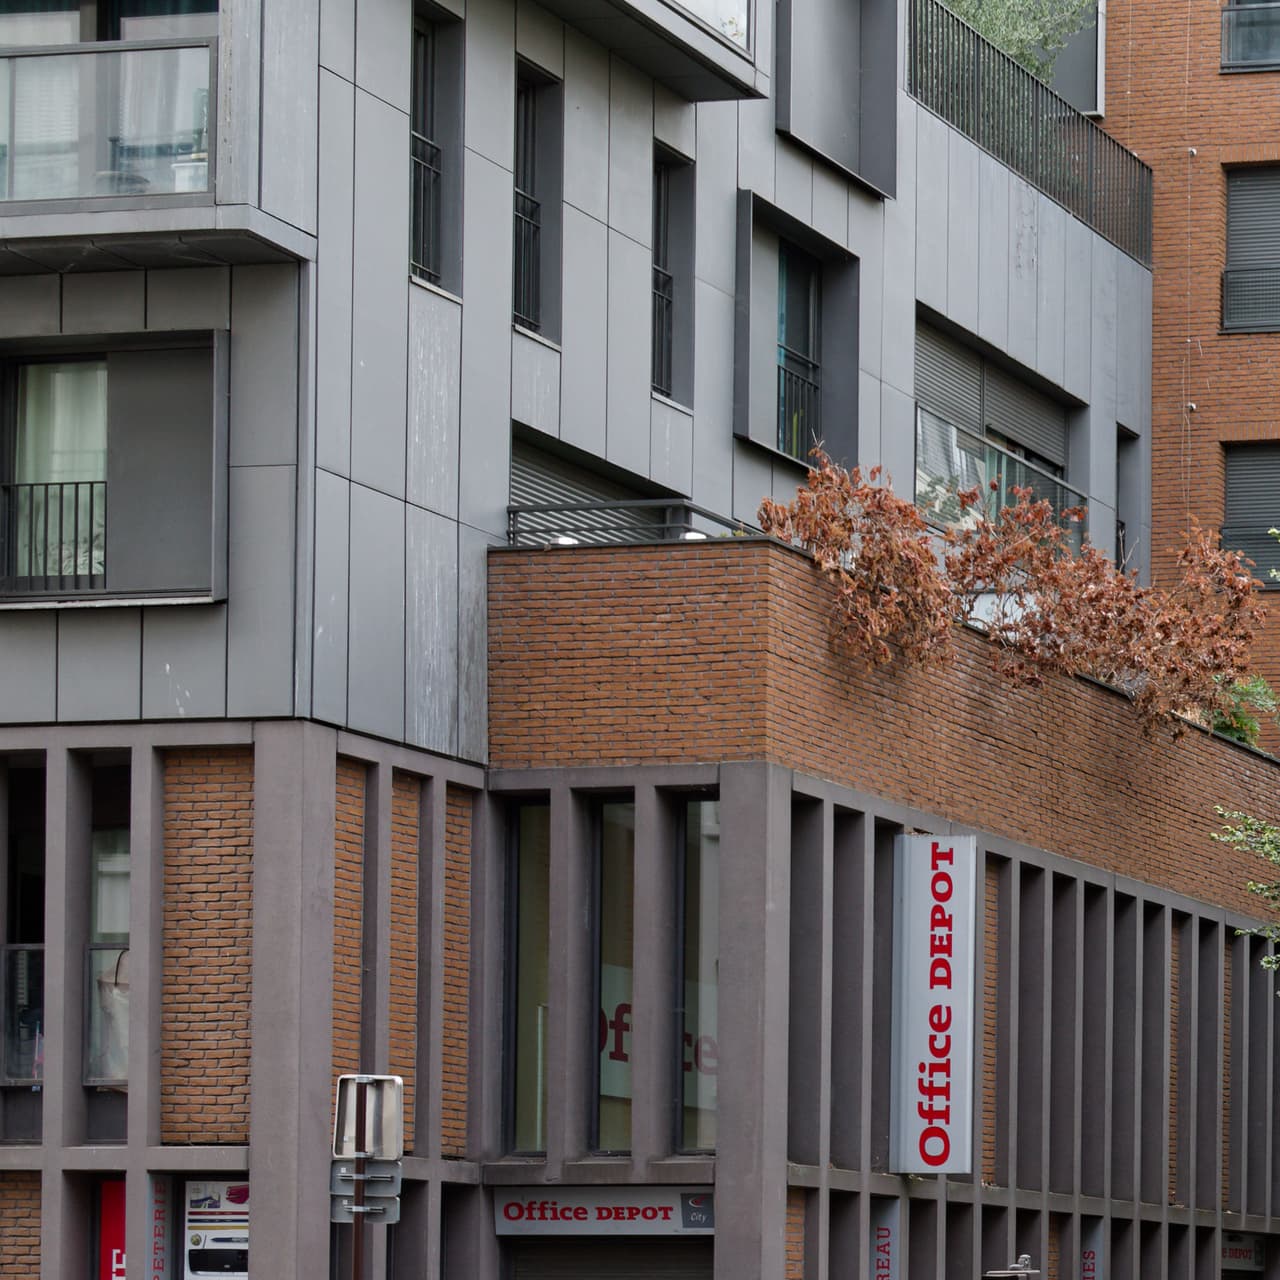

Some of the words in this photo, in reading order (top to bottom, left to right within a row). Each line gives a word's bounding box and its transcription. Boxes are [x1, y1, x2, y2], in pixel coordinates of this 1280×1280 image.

[929, 841, 954, 990] DEPOT
[917, 1004, 953, 1167] Office
[503, 1201, 588, 1221] Office
[595, 1206, 673, 1221] DEPOT
[690, 1212, 707, 1223] City
